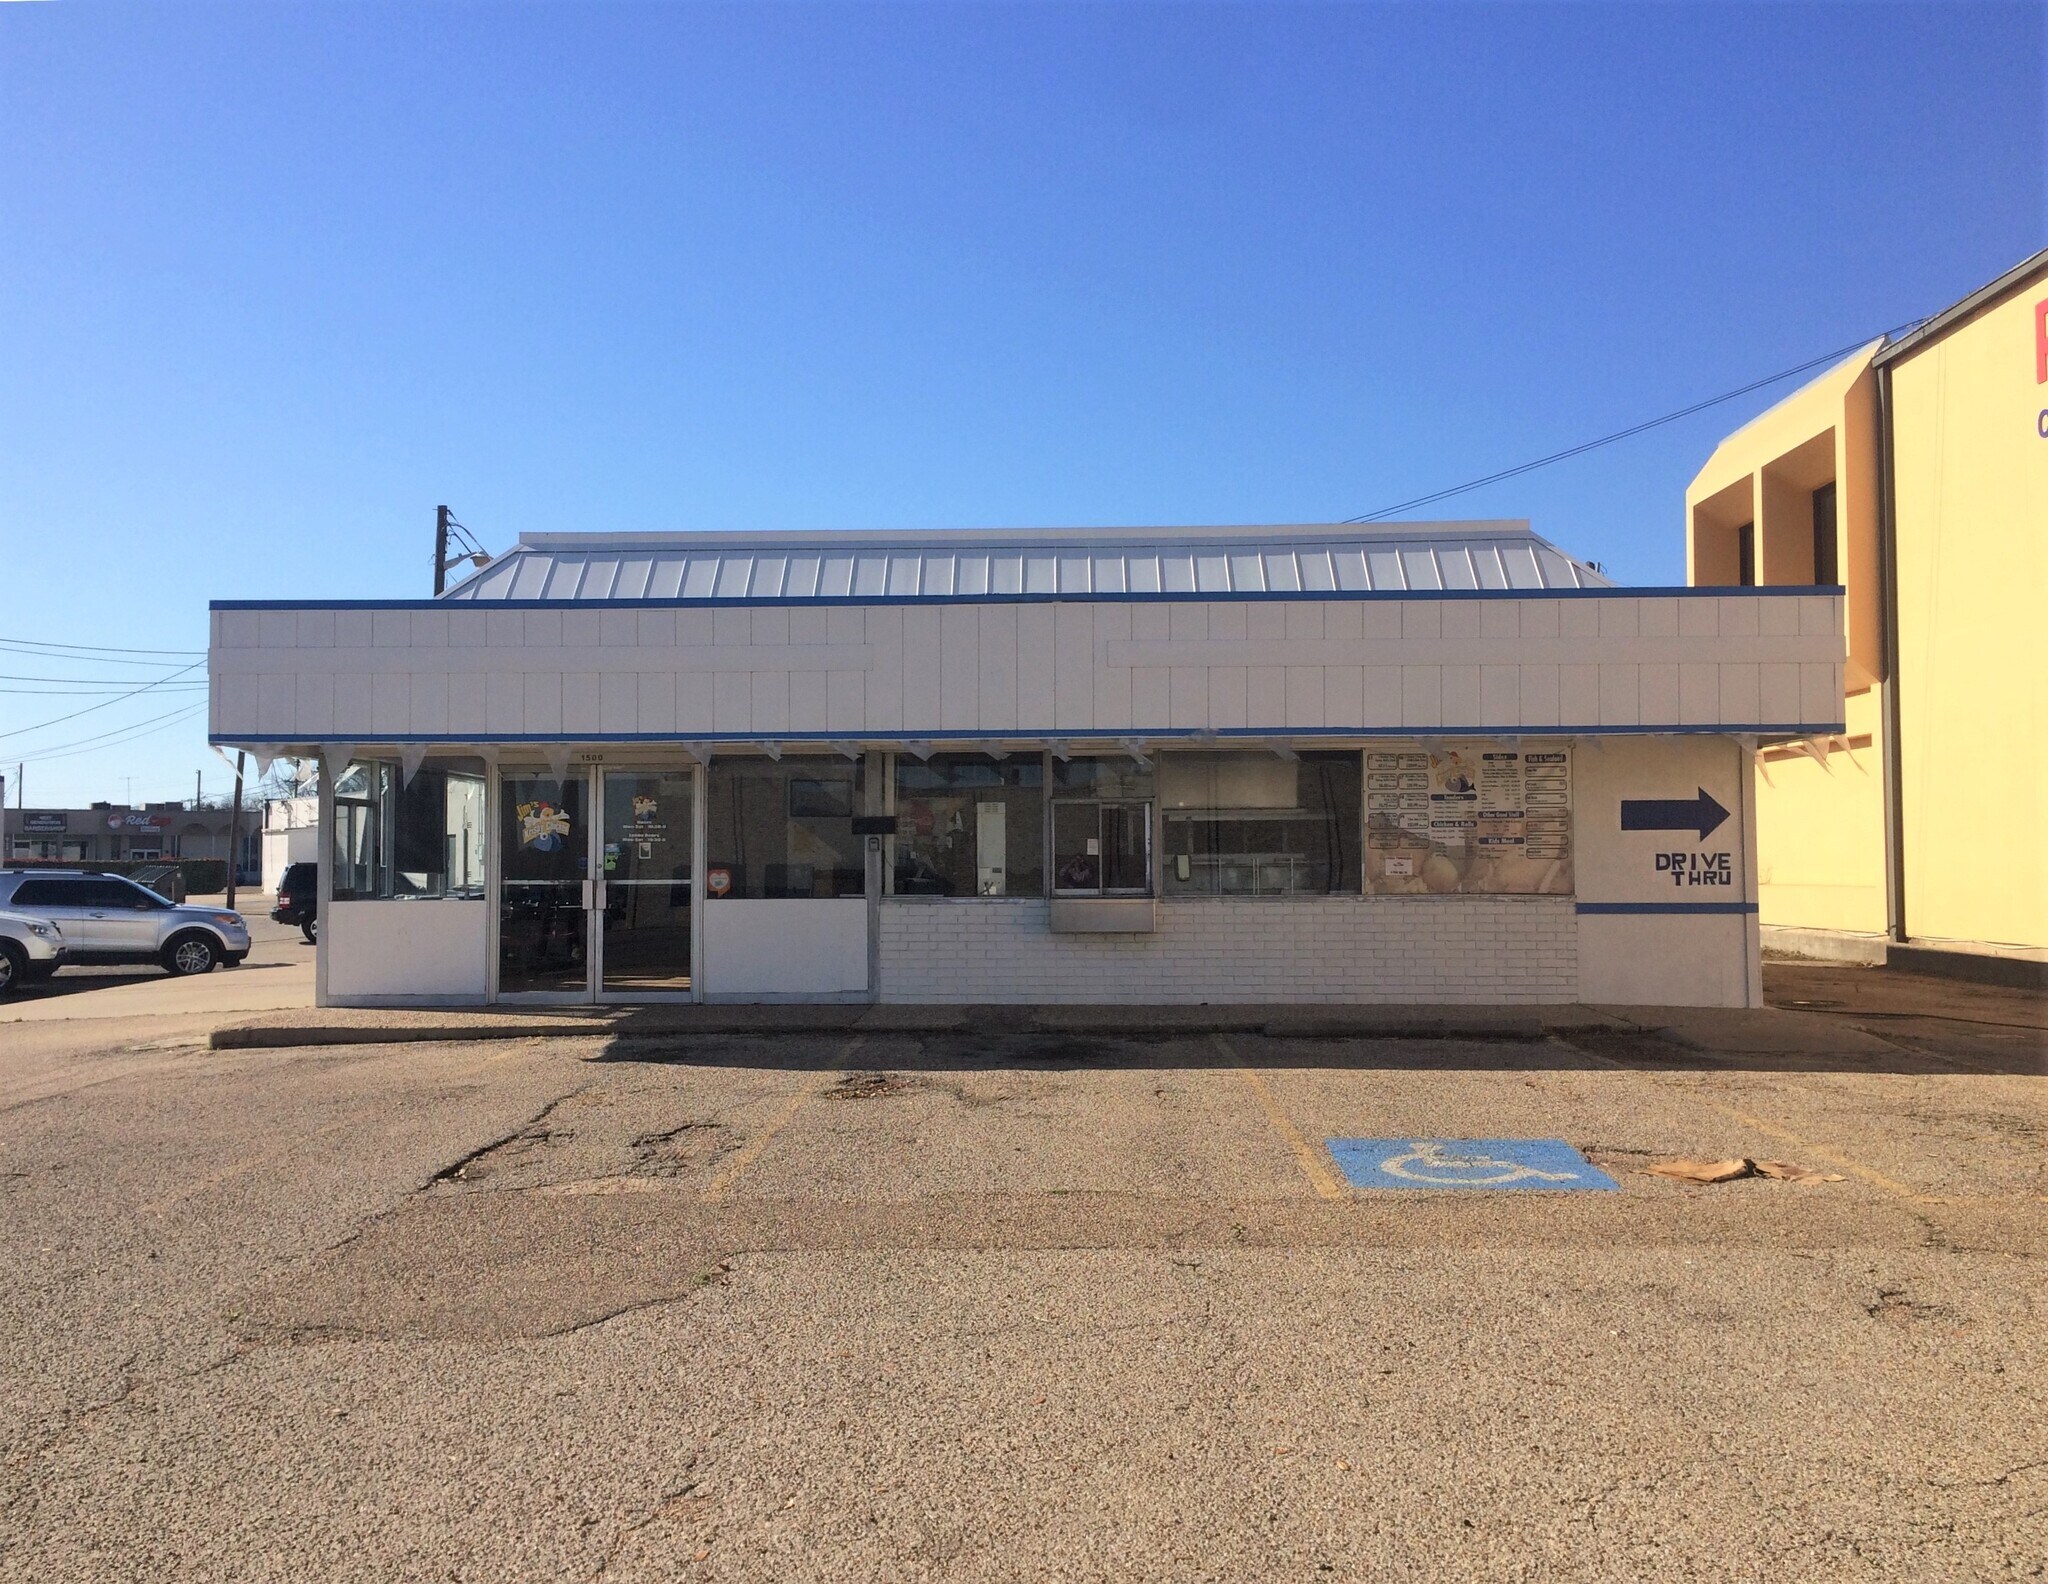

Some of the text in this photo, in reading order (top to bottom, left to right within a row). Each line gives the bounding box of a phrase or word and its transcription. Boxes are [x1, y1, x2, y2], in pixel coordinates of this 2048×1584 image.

[125, 815, 152, 825] Red
[516, 801, 539, 822] Jim's
[1655, 852, 1731, 871] DRIVE
[1671, 871, 1731, 887] THRU
